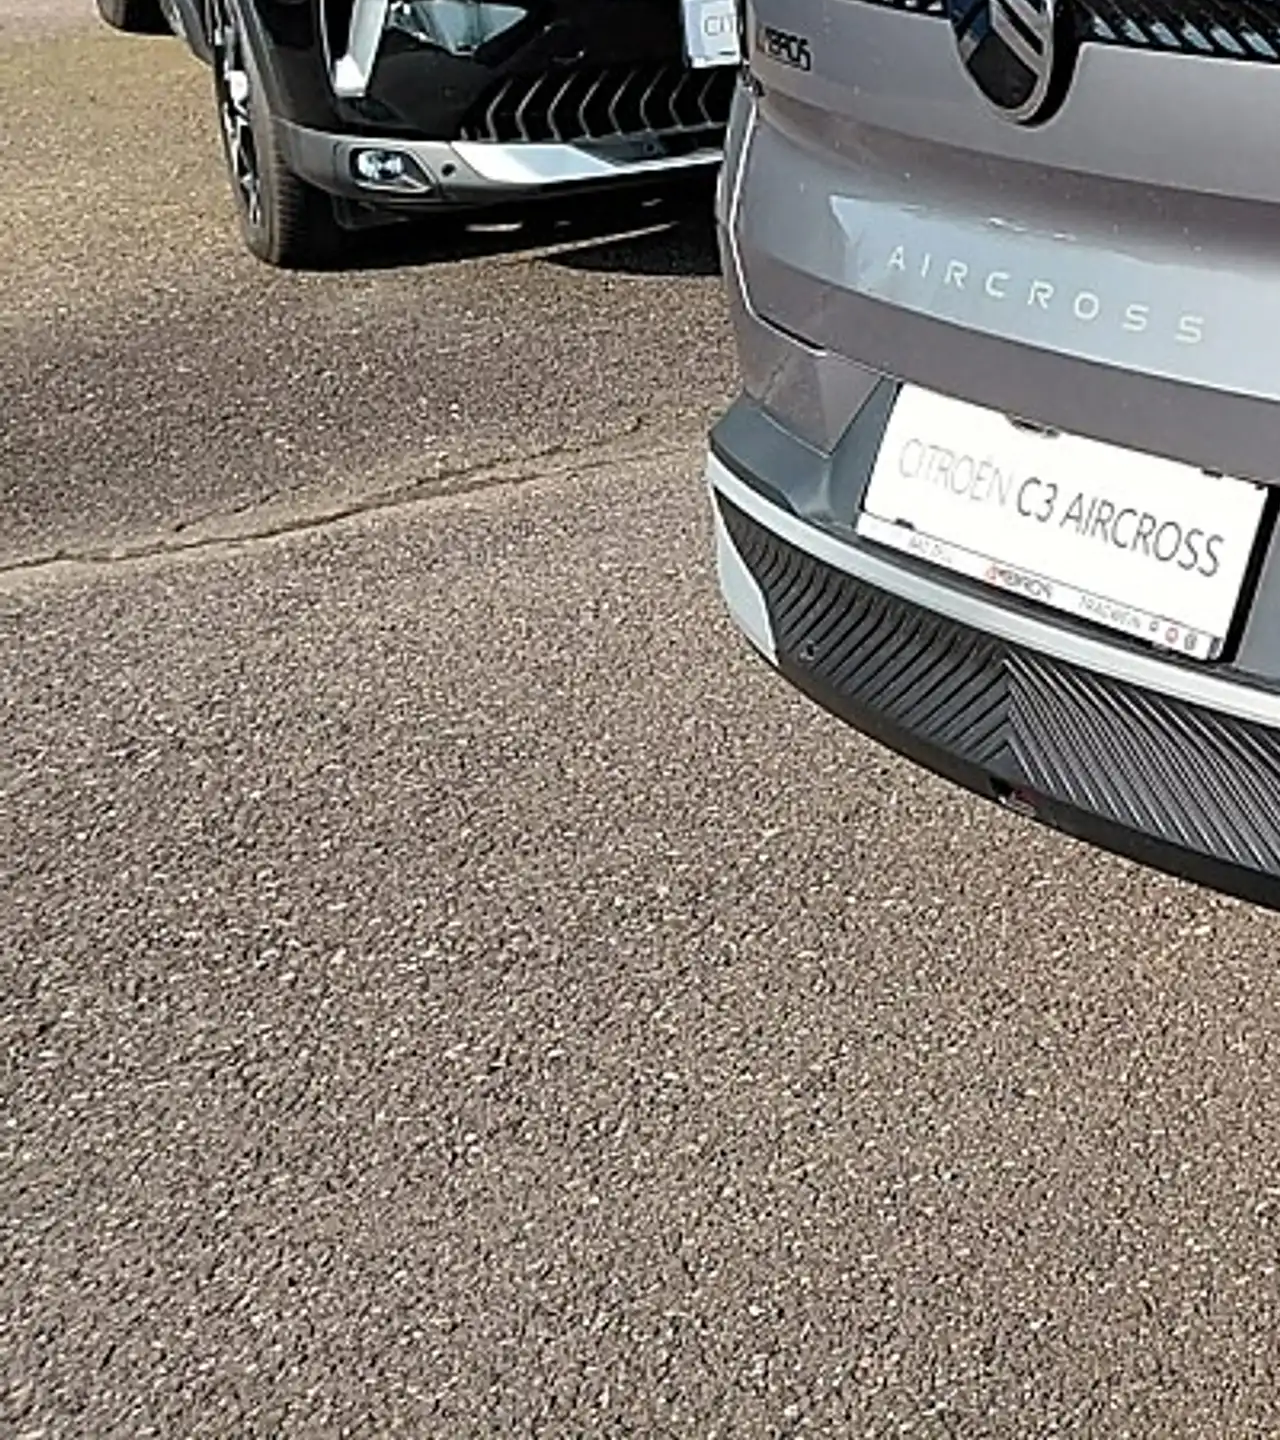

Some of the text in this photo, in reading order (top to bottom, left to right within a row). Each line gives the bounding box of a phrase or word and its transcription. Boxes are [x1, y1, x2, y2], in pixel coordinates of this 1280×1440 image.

[886, 245, 1205, 345] AIRCROSS
[898, 438, 1225, 579] CITROËN C3 AIRCROSS
